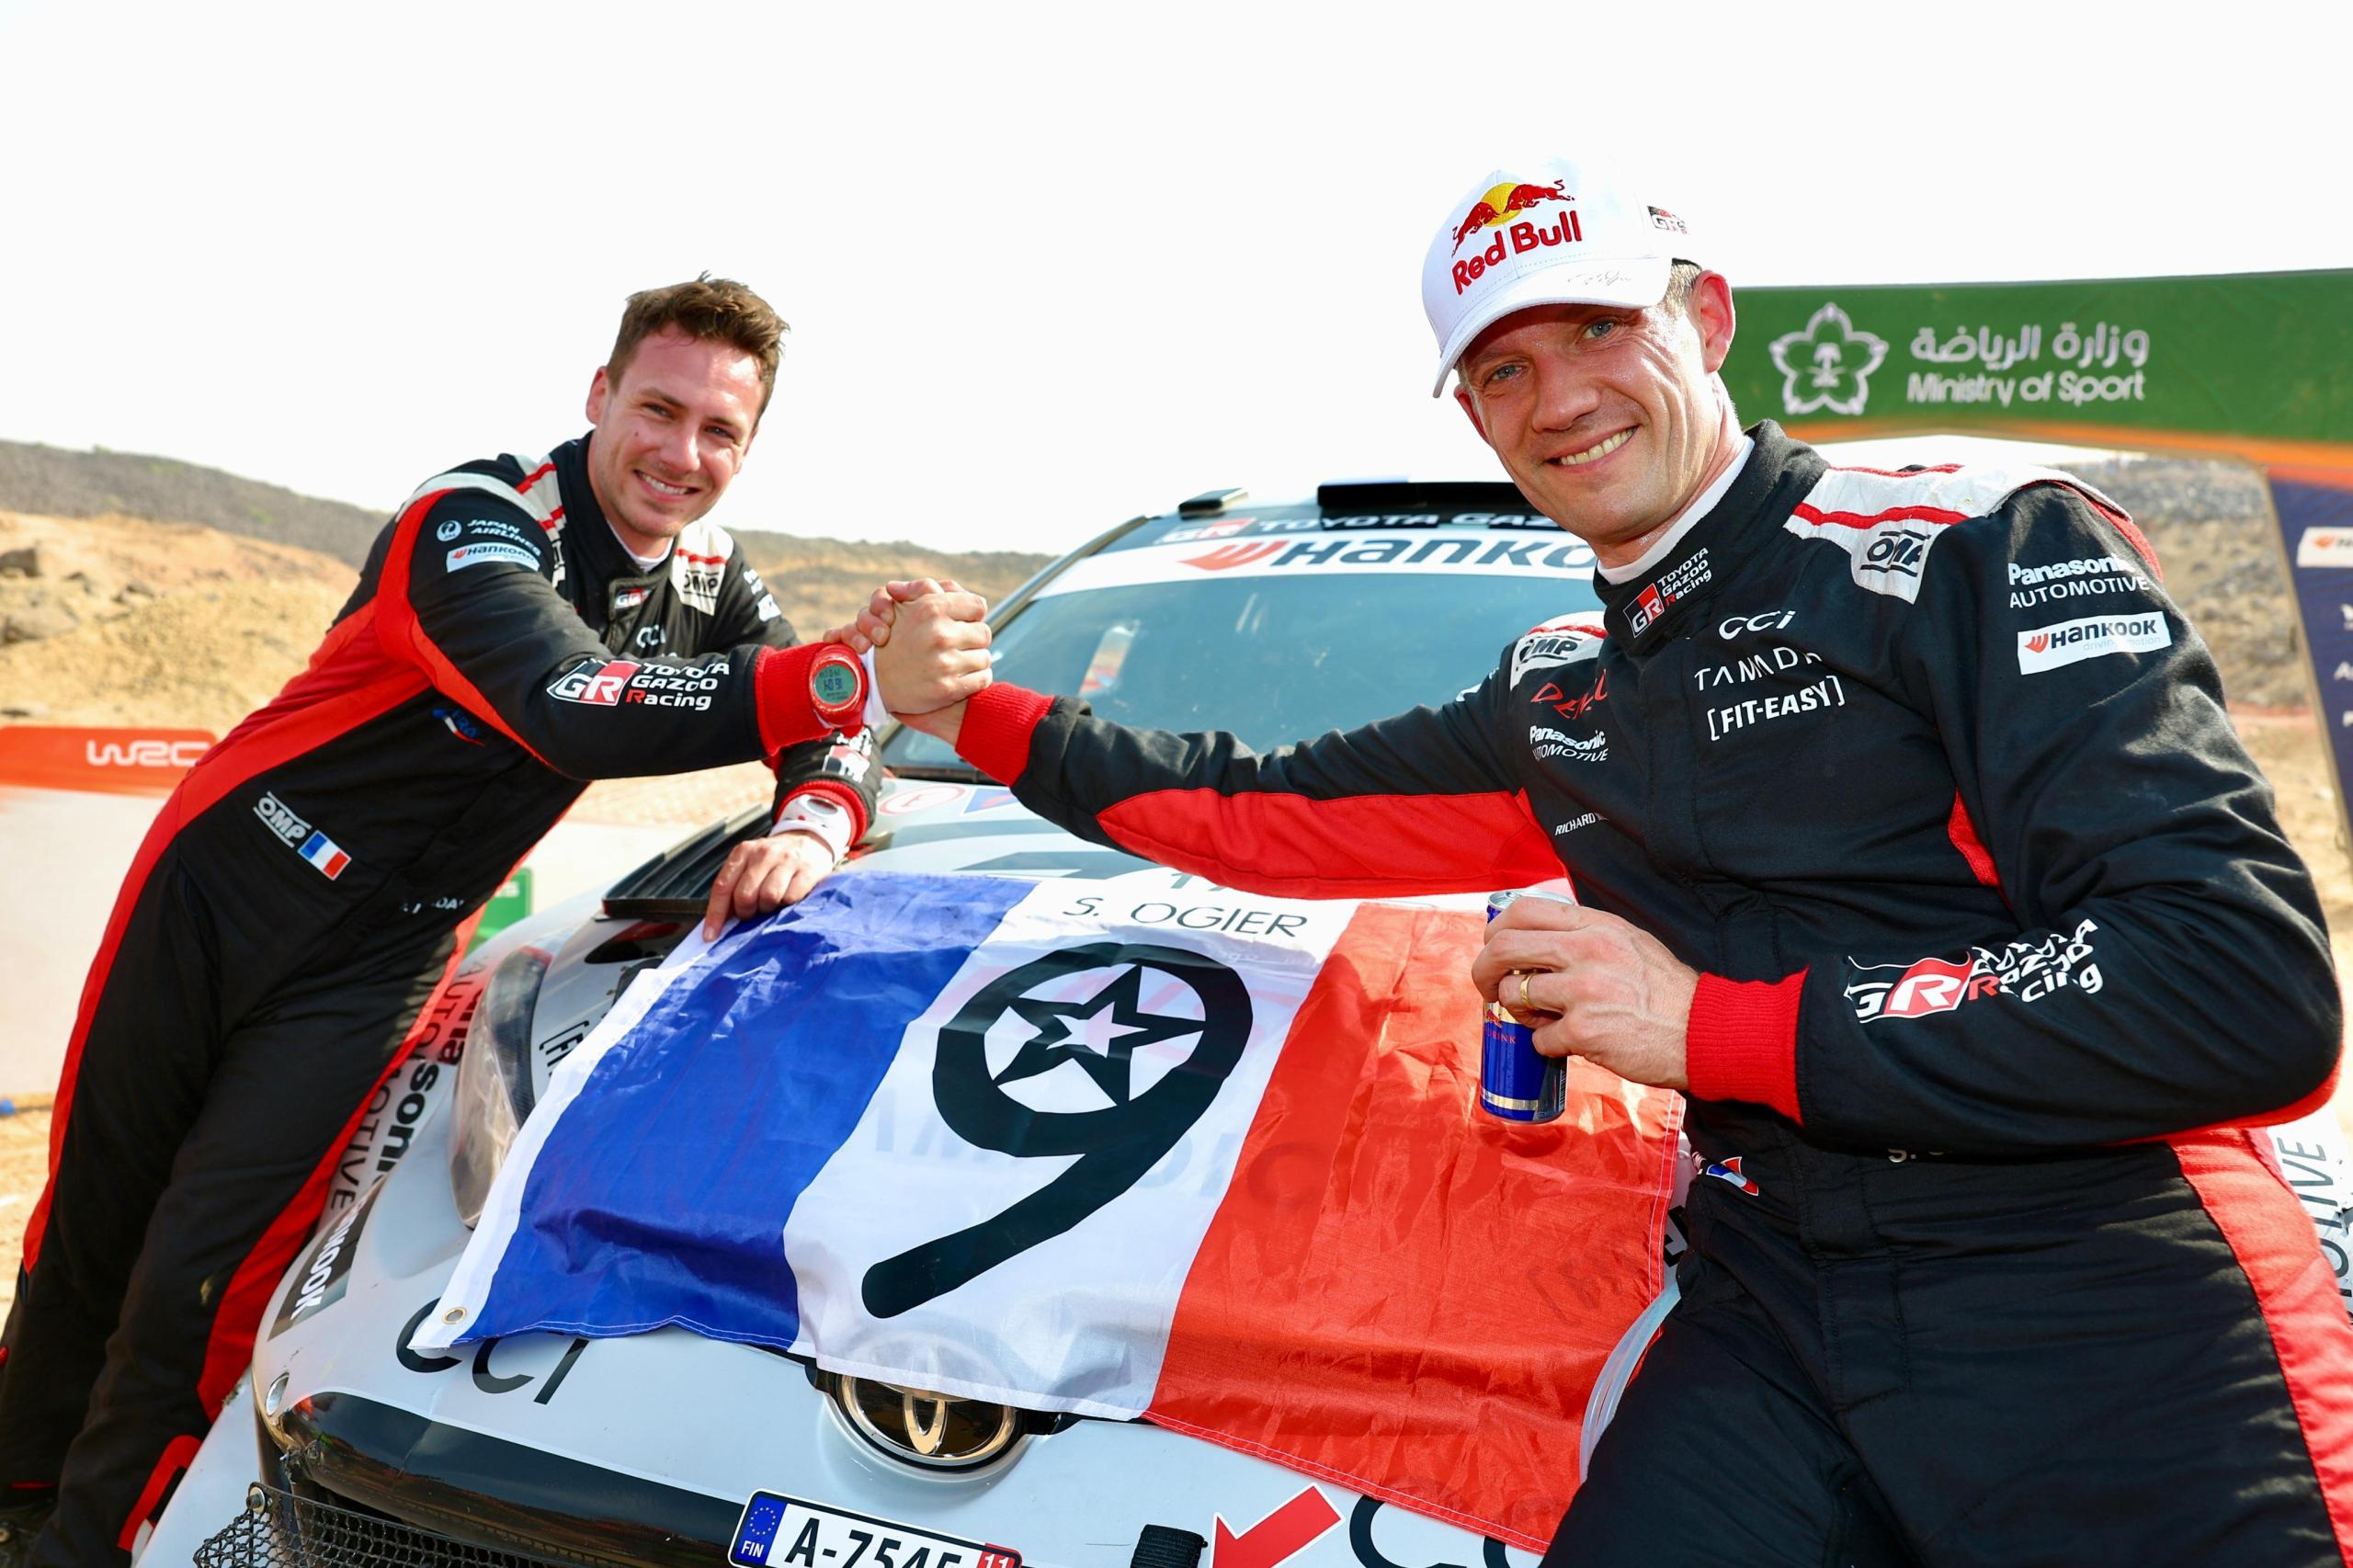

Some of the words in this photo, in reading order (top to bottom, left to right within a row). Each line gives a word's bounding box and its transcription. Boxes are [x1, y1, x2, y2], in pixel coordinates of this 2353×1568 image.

[1450, 230, 1506, 295] Red
[1509, 210, 1582, 255] Bull
[1910, 325, 2041, 370] الرياضة
[2052, 322, 2149, 368] وزارة
[1907, 371, 2015, 407] Ministry
[2019, 370, 2054, 402] of
[2058, 369, 2145, 406] Sport
[467, 519, 520, 533] JAPAN
[1256, 514, 1439, 532] TOYOTA
[471, 527, 541, 557] AIRLINES
[1270, 539, 1596, 568] Hanko
[1657, 548, 1709, 586] TOYOTA
[1662, 559, 1709, 597] GAZOO
[1665, 569, 1712, 607] Racing
[2009, 576, 2150, 608] AUTOMOTIVE
[1631, 597, 1663, 633] GR
[2051, 619, 2157, 649] Hankook
[554, 673, 624, 703] GR
[631, 675, 718, 691] GAZOO
[625, 688, 712, 710] Racing
[1707, 675, 1846, 742] [FIT-EASY]
[86, 739, 210, 767] WRC
[1529, 725, 1606, 750] Panasonic
[257, 796, 307, 843] OMP
[1554, 812, 1597, 836] RICHARD
[1063, 897, 1101, 917] S.
[1130, 902, 1308, 938] OGIER
[740, 1540, 765, 1558] FIN
